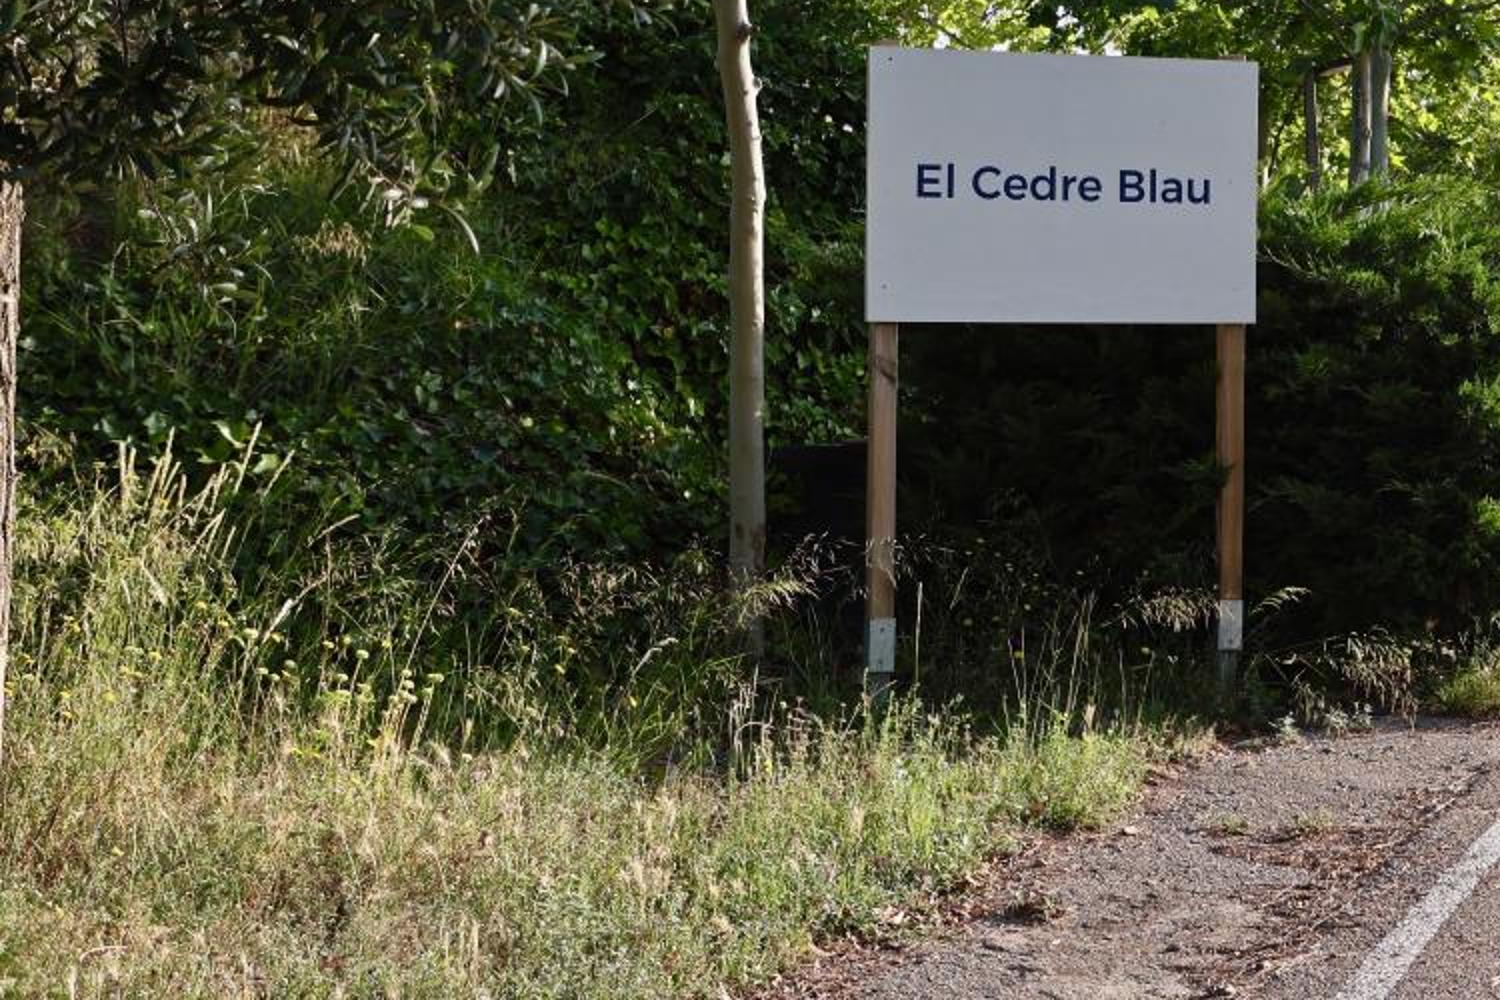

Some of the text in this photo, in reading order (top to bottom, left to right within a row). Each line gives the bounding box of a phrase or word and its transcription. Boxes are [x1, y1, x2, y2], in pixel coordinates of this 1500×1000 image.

[916, 162, 1211, 205] El Cedre Blau
